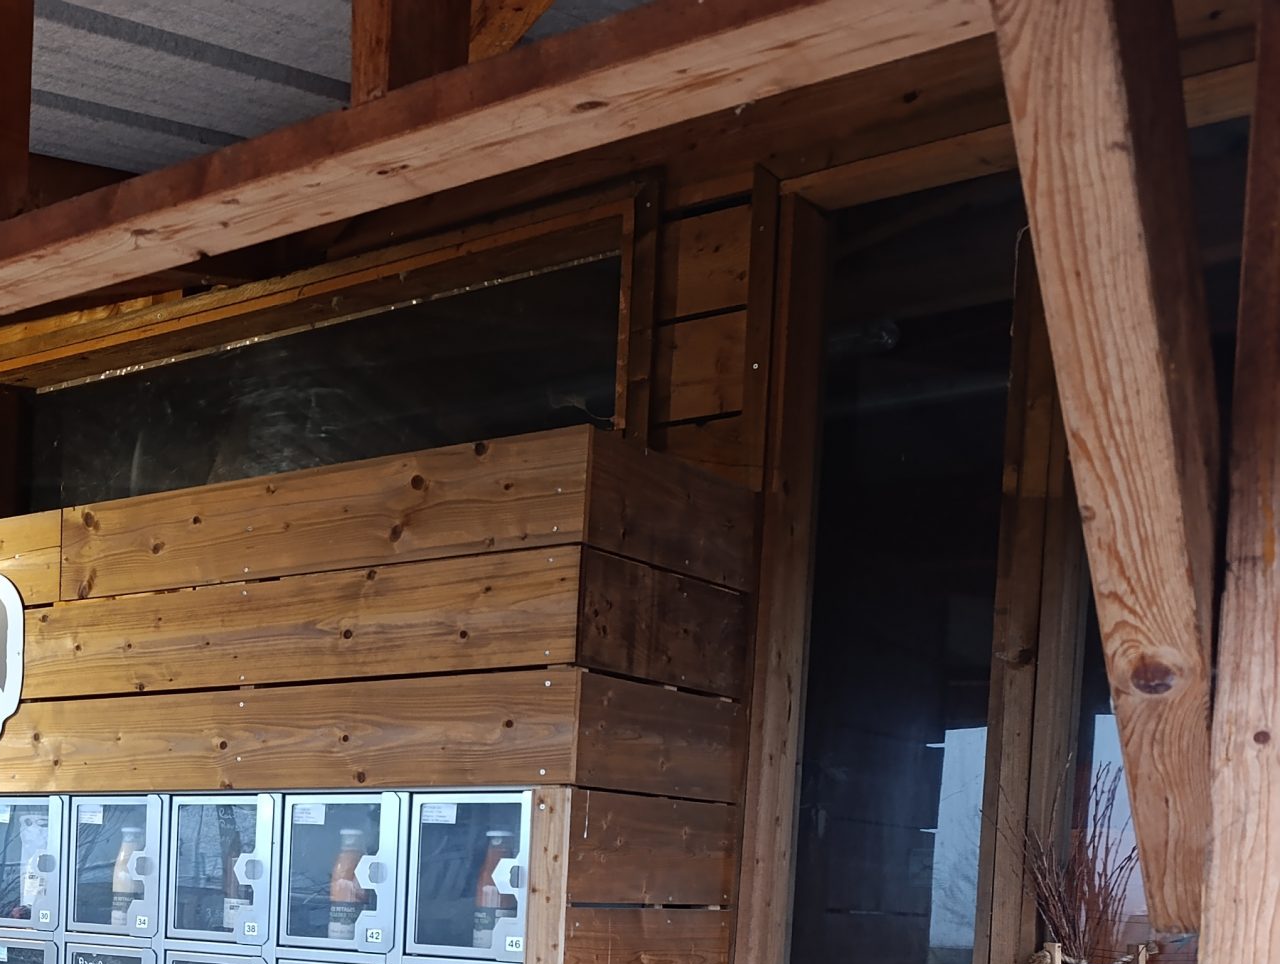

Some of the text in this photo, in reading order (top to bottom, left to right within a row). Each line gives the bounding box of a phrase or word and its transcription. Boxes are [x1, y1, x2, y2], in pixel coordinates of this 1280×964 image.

[40, 912, 49, 920] 30
[137, 918, 146, 926] 34
[246, 925, 256, 933] 38
[369, 931, 380, 940] 42
[508, 939, 521, 949] 46
